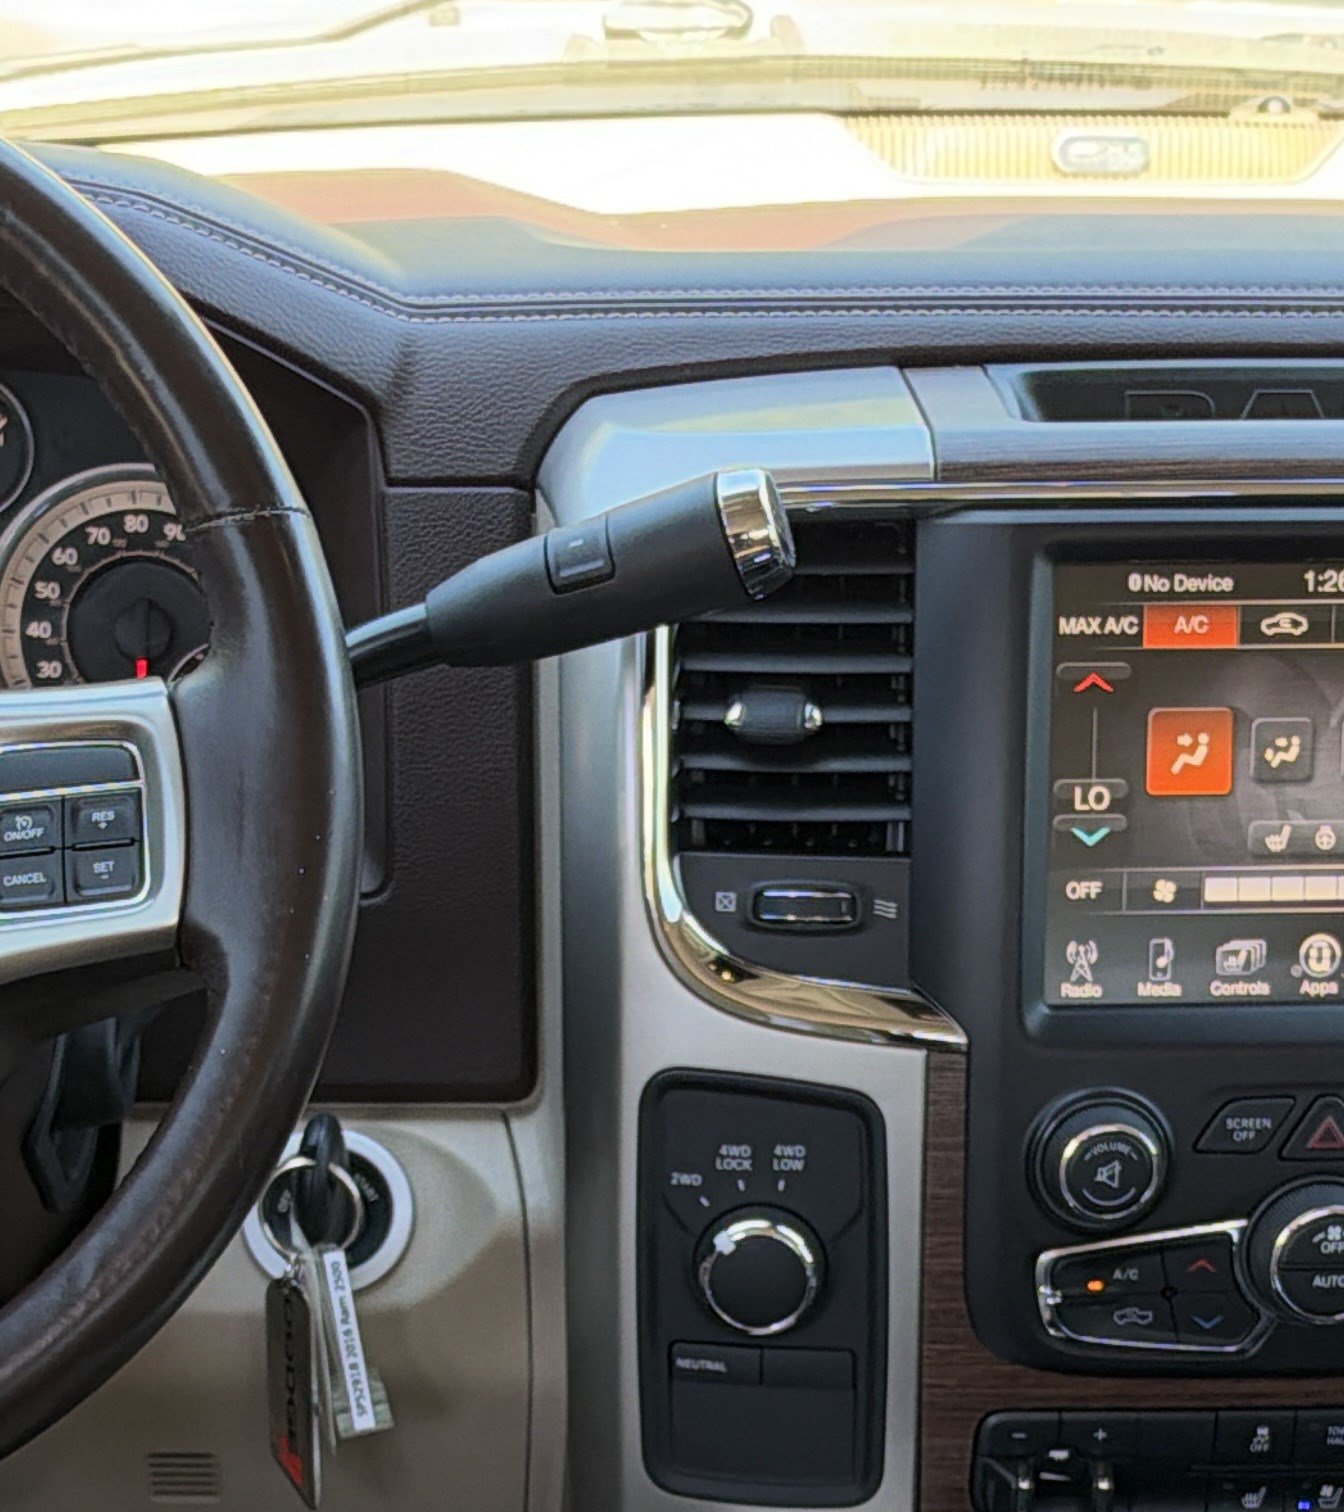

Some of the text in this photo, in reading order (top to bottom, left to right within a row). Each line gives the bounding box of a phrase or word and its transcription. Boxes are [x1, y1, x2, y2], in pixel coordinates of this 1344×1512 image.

[123, 514, 149, 533] 80
[85, 526, 111, 546] 70
[52, 547, 78, 566] 60
[34, 581, 60, 600] 50
[1144, 572, 1234, 592] No Device
[25, 621, 52, 639] 40
[1059, 615, 1139, 635] MAX A/C
[1173, 615, 1210, 634] A/C
[36, 660, 62, 678] 30
[1074, 785, 1110, 811] LO
[92, 811, 115, 822] RES
[93, 861, 114, 874] SET
[3, 871, 47, 887] CANCEL
[1065, 881, 1102, 900] OFF
[1061, 981, 1103, 997] Radio
[1137, 980, 1182, 997] Media
[1210, 980, 1270, 997] Controls
[1299, 979, 1339, 998] Apps
[1226, 1117, 1272, 1129] SCREEN
[1233, 1130, 1256, 1142] OFF
[719, 1143, 752, 1157] 4WD
[773, 1143, 806, 1157] 4WD
[715, 1157, 753, 1171] LOCK
[773, 1158, 805, 1171] LOW
[670, 1171, 703, 1187] 2WD
[1113, 1268, 1139, 1281] A/C
